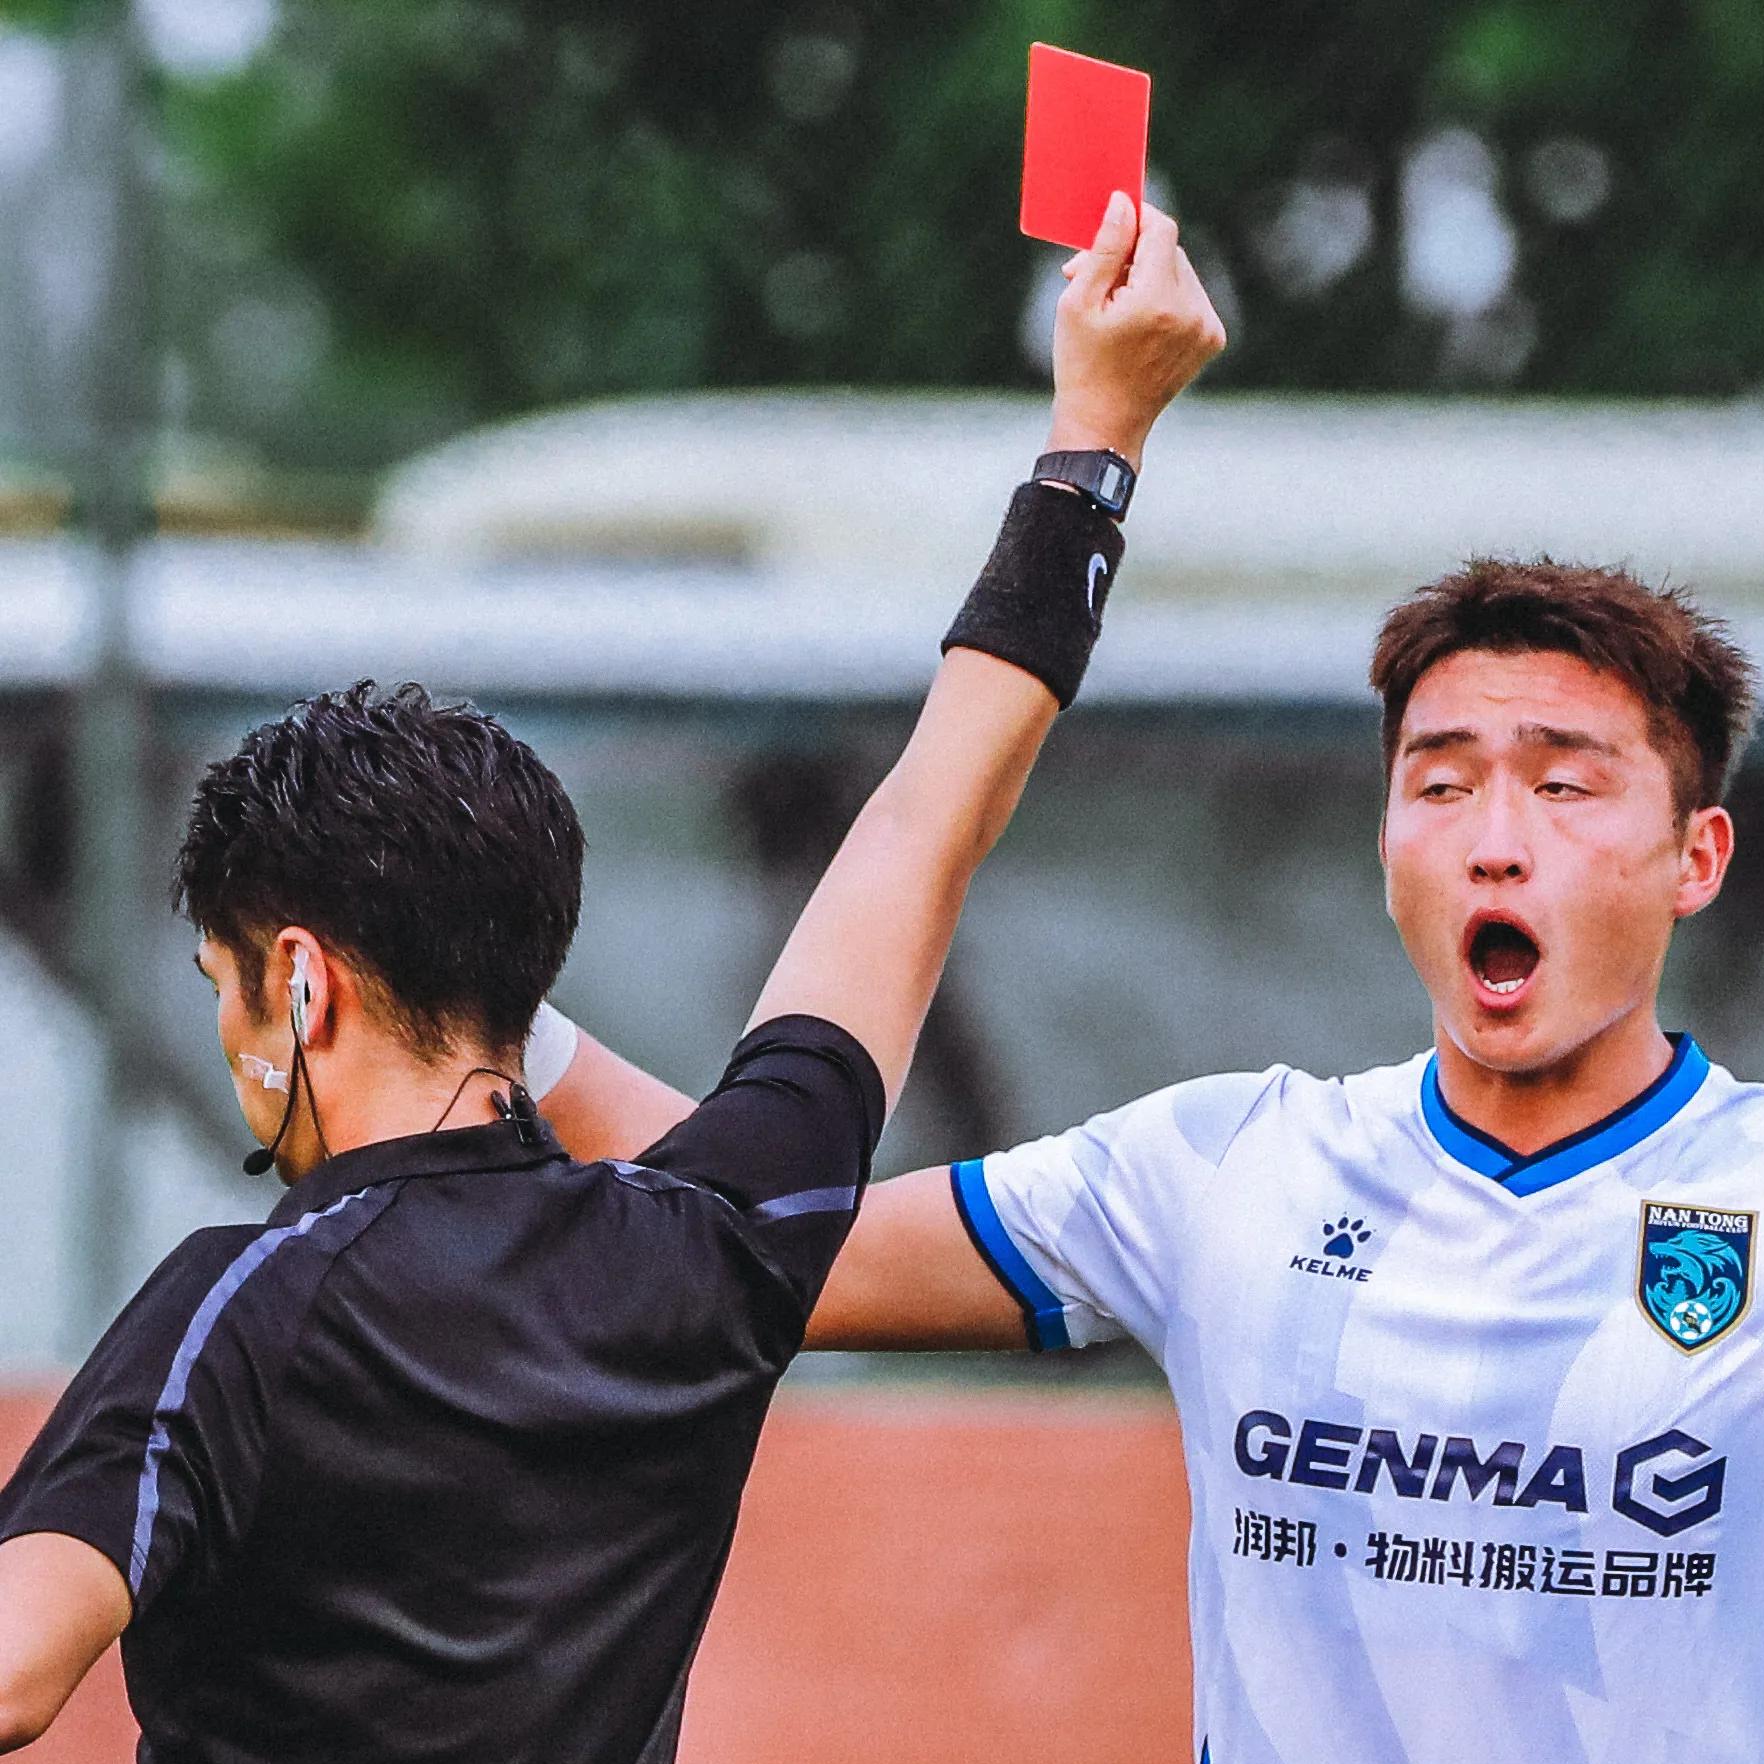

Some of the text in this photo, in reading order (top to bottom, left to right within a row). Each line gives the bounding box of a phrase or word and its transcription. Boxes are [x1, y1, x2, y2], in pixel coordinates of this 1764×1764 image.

[1648, 1205, 1749, 1228] NAN TONG
[1289, 1254, 1374, 1283] KELME
[1233, 1409, 1590, 1514] GENMA
